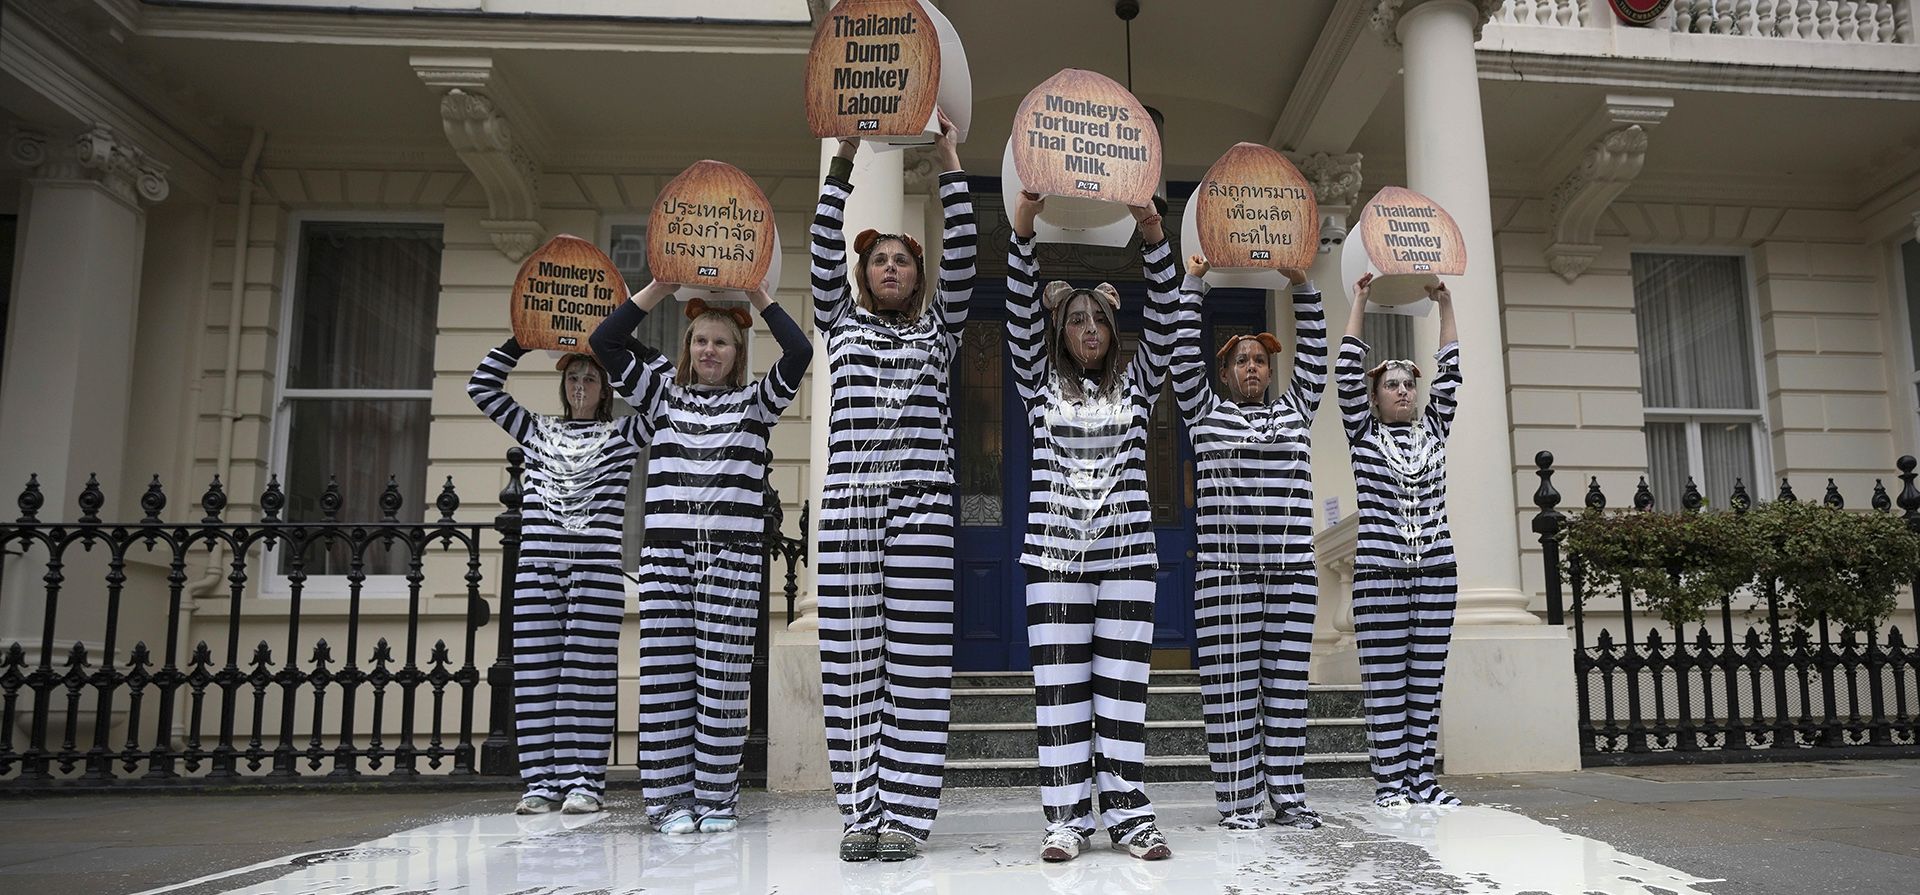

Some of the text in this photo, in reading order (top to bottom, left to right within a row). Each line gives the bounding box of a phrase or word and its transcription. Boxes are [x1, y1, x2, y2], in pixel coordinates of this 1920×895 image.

[833, 12, 917, 38] Thailand:
[845, 41, 900, 64] Dump
[833, 66, 909, 91] Monkey
[837, 93, 902, 116] Labour
[1045, 94, 1129, 122] Monkeys
[1032, 111, 1142, 142] Tortured for
[1027, 130, 1148, 162] Thai Coconut
[1065, 154, 1111, 177] Milk.
[1208, 181, 1307, 201] ลิงถูกทรมาน
[663, 197, 765, 223] ประเทศไทย
[1226, 201, 1292, 221] เพื่อผลิต
[1373, 204, 1438, 218] Thailand:
[668, 216, 756, 242] ต้องกำจัด
[1229, 225, 1292, 245] กะทิไทย
[1388, 219, 1430, 233] Dump
[664, 241, 755, 263] แรงงานลิง
[1384, 233, 1441, 249] Monkey
[1392, 248, 1441, 262] Labour
[538, 261, 605, 283] Monkeys
[528, 277, 614, 301] Tortured for
[523, 294, 553, 312] Thai
[551, 314, 586, 333] Milk.
